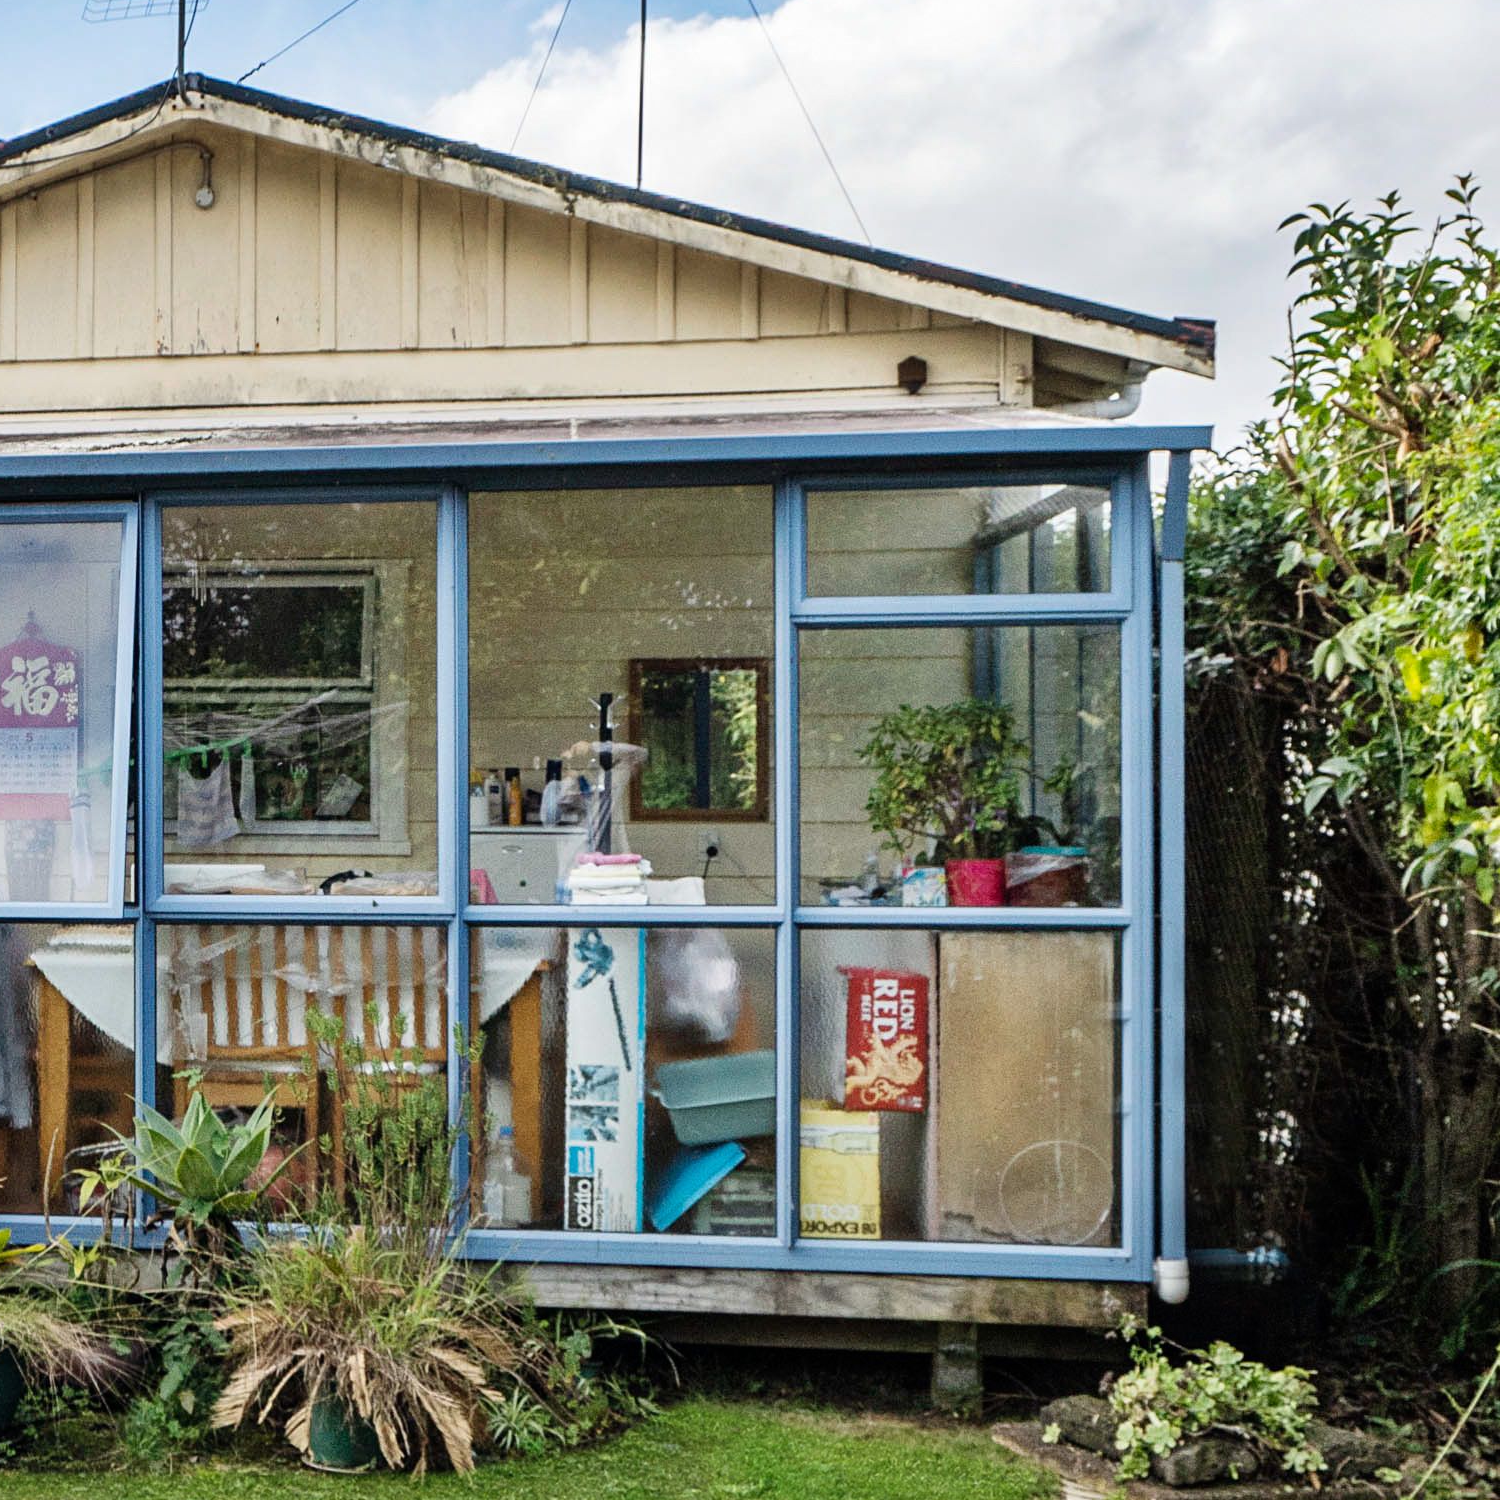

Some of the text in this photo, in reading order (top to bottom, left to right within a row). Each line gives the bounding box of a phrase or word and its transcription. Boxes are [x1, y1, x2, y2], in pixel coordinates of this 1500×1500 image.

[1, 656, 59, 716] 福
[873, 979, 899, 1040] RED
[900, 989, 916, 1030] LION
[574, 1178, 592, 1227] ozito
